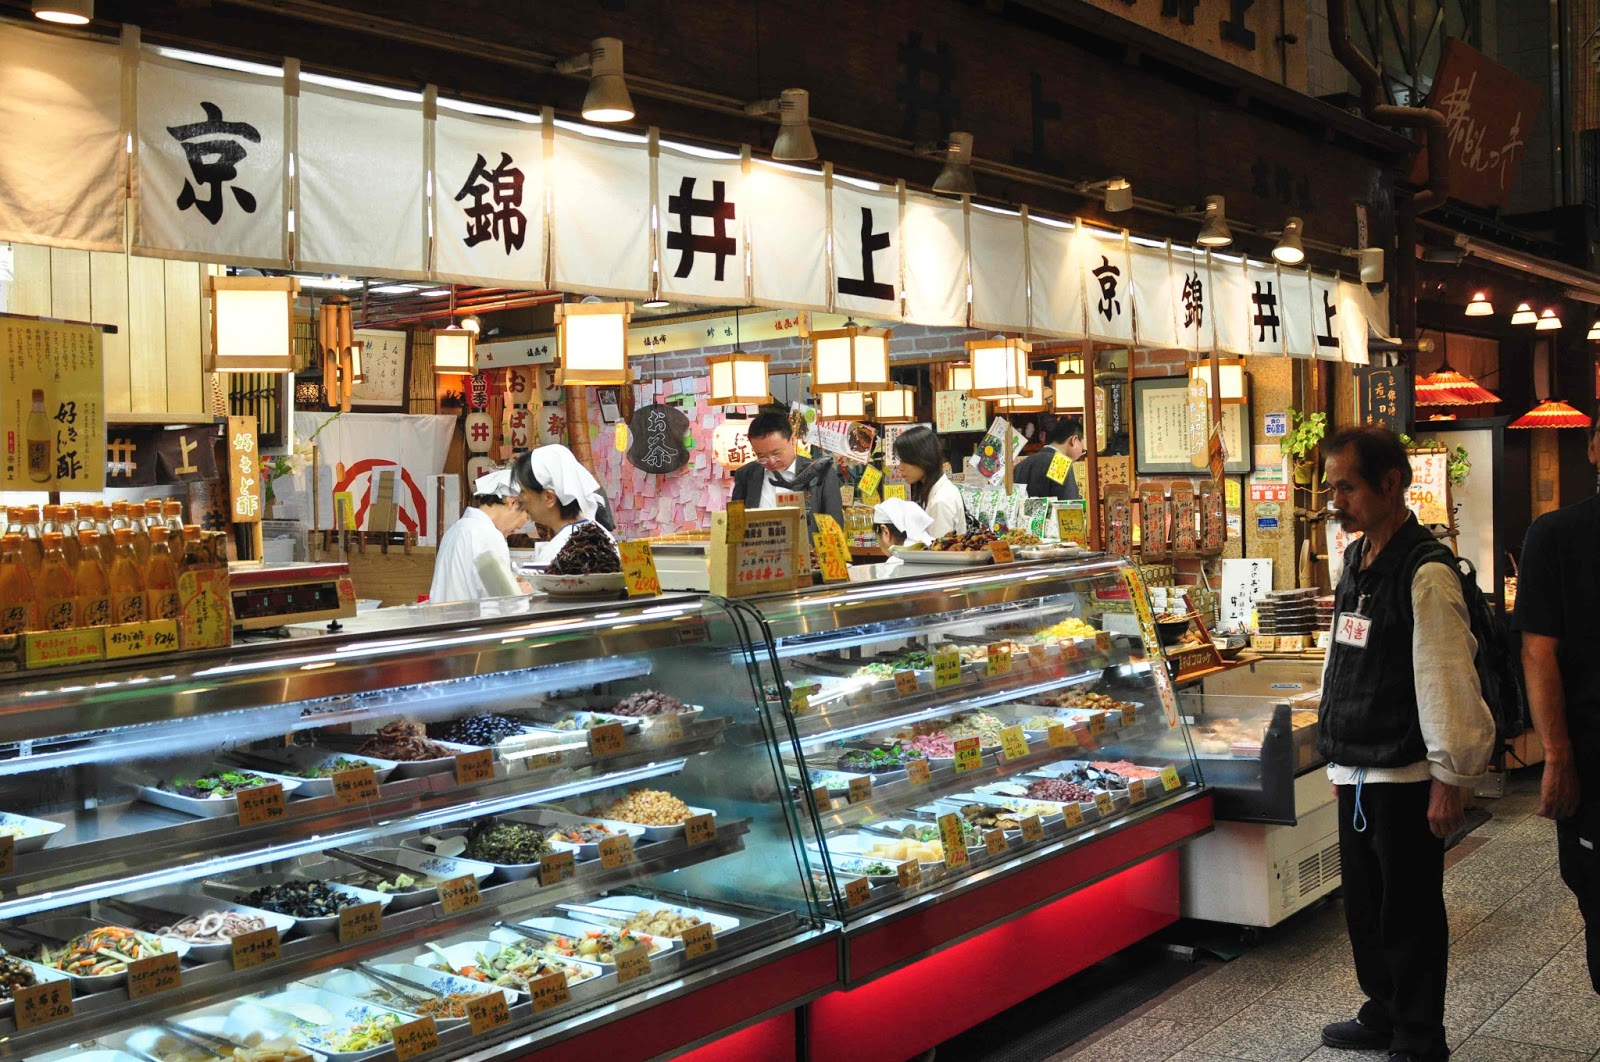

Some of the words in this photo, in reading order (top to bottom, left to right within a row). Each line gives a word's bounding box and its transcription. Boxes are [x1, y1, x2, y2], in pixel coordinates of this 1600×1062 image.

[667, 176, 736, 281] 井
[838, 207, 895, 301] 上
[174, 435, 198, 475] 上
[641, 410, 679, 468] お茶
[232, 433, 259, 517] 好きど酢
[1409, 490, 1434, 506] 540
[48, 1005, 70, 1017] 260
